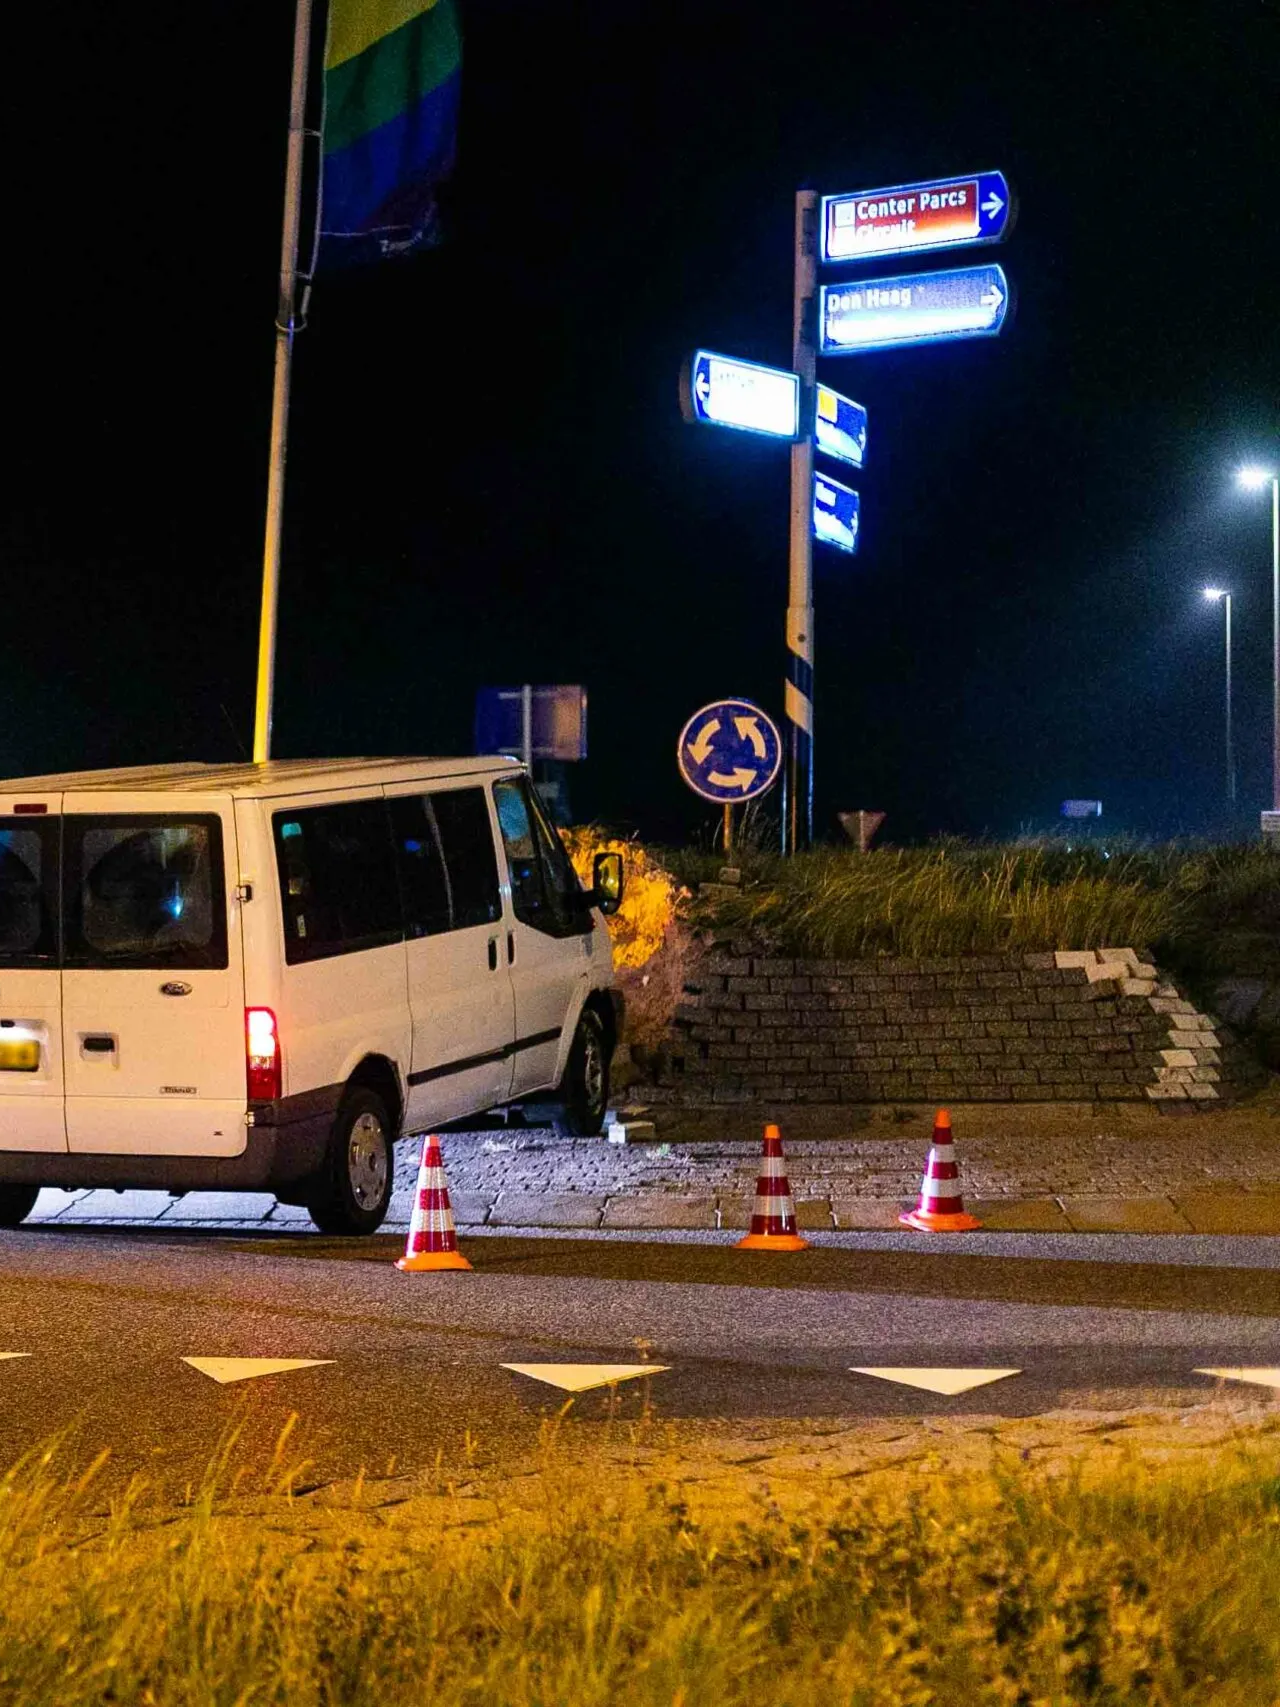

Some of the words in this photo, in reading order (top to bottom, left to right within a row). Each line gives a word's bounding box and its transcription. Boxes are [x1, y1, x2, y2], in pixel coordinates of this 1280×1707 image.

[857, 198, 915, 220] Center
[920, 190, 967, 211] Parcs
[827, 293, 862, 313] Den
[866, 287, 912, 309] Haag
